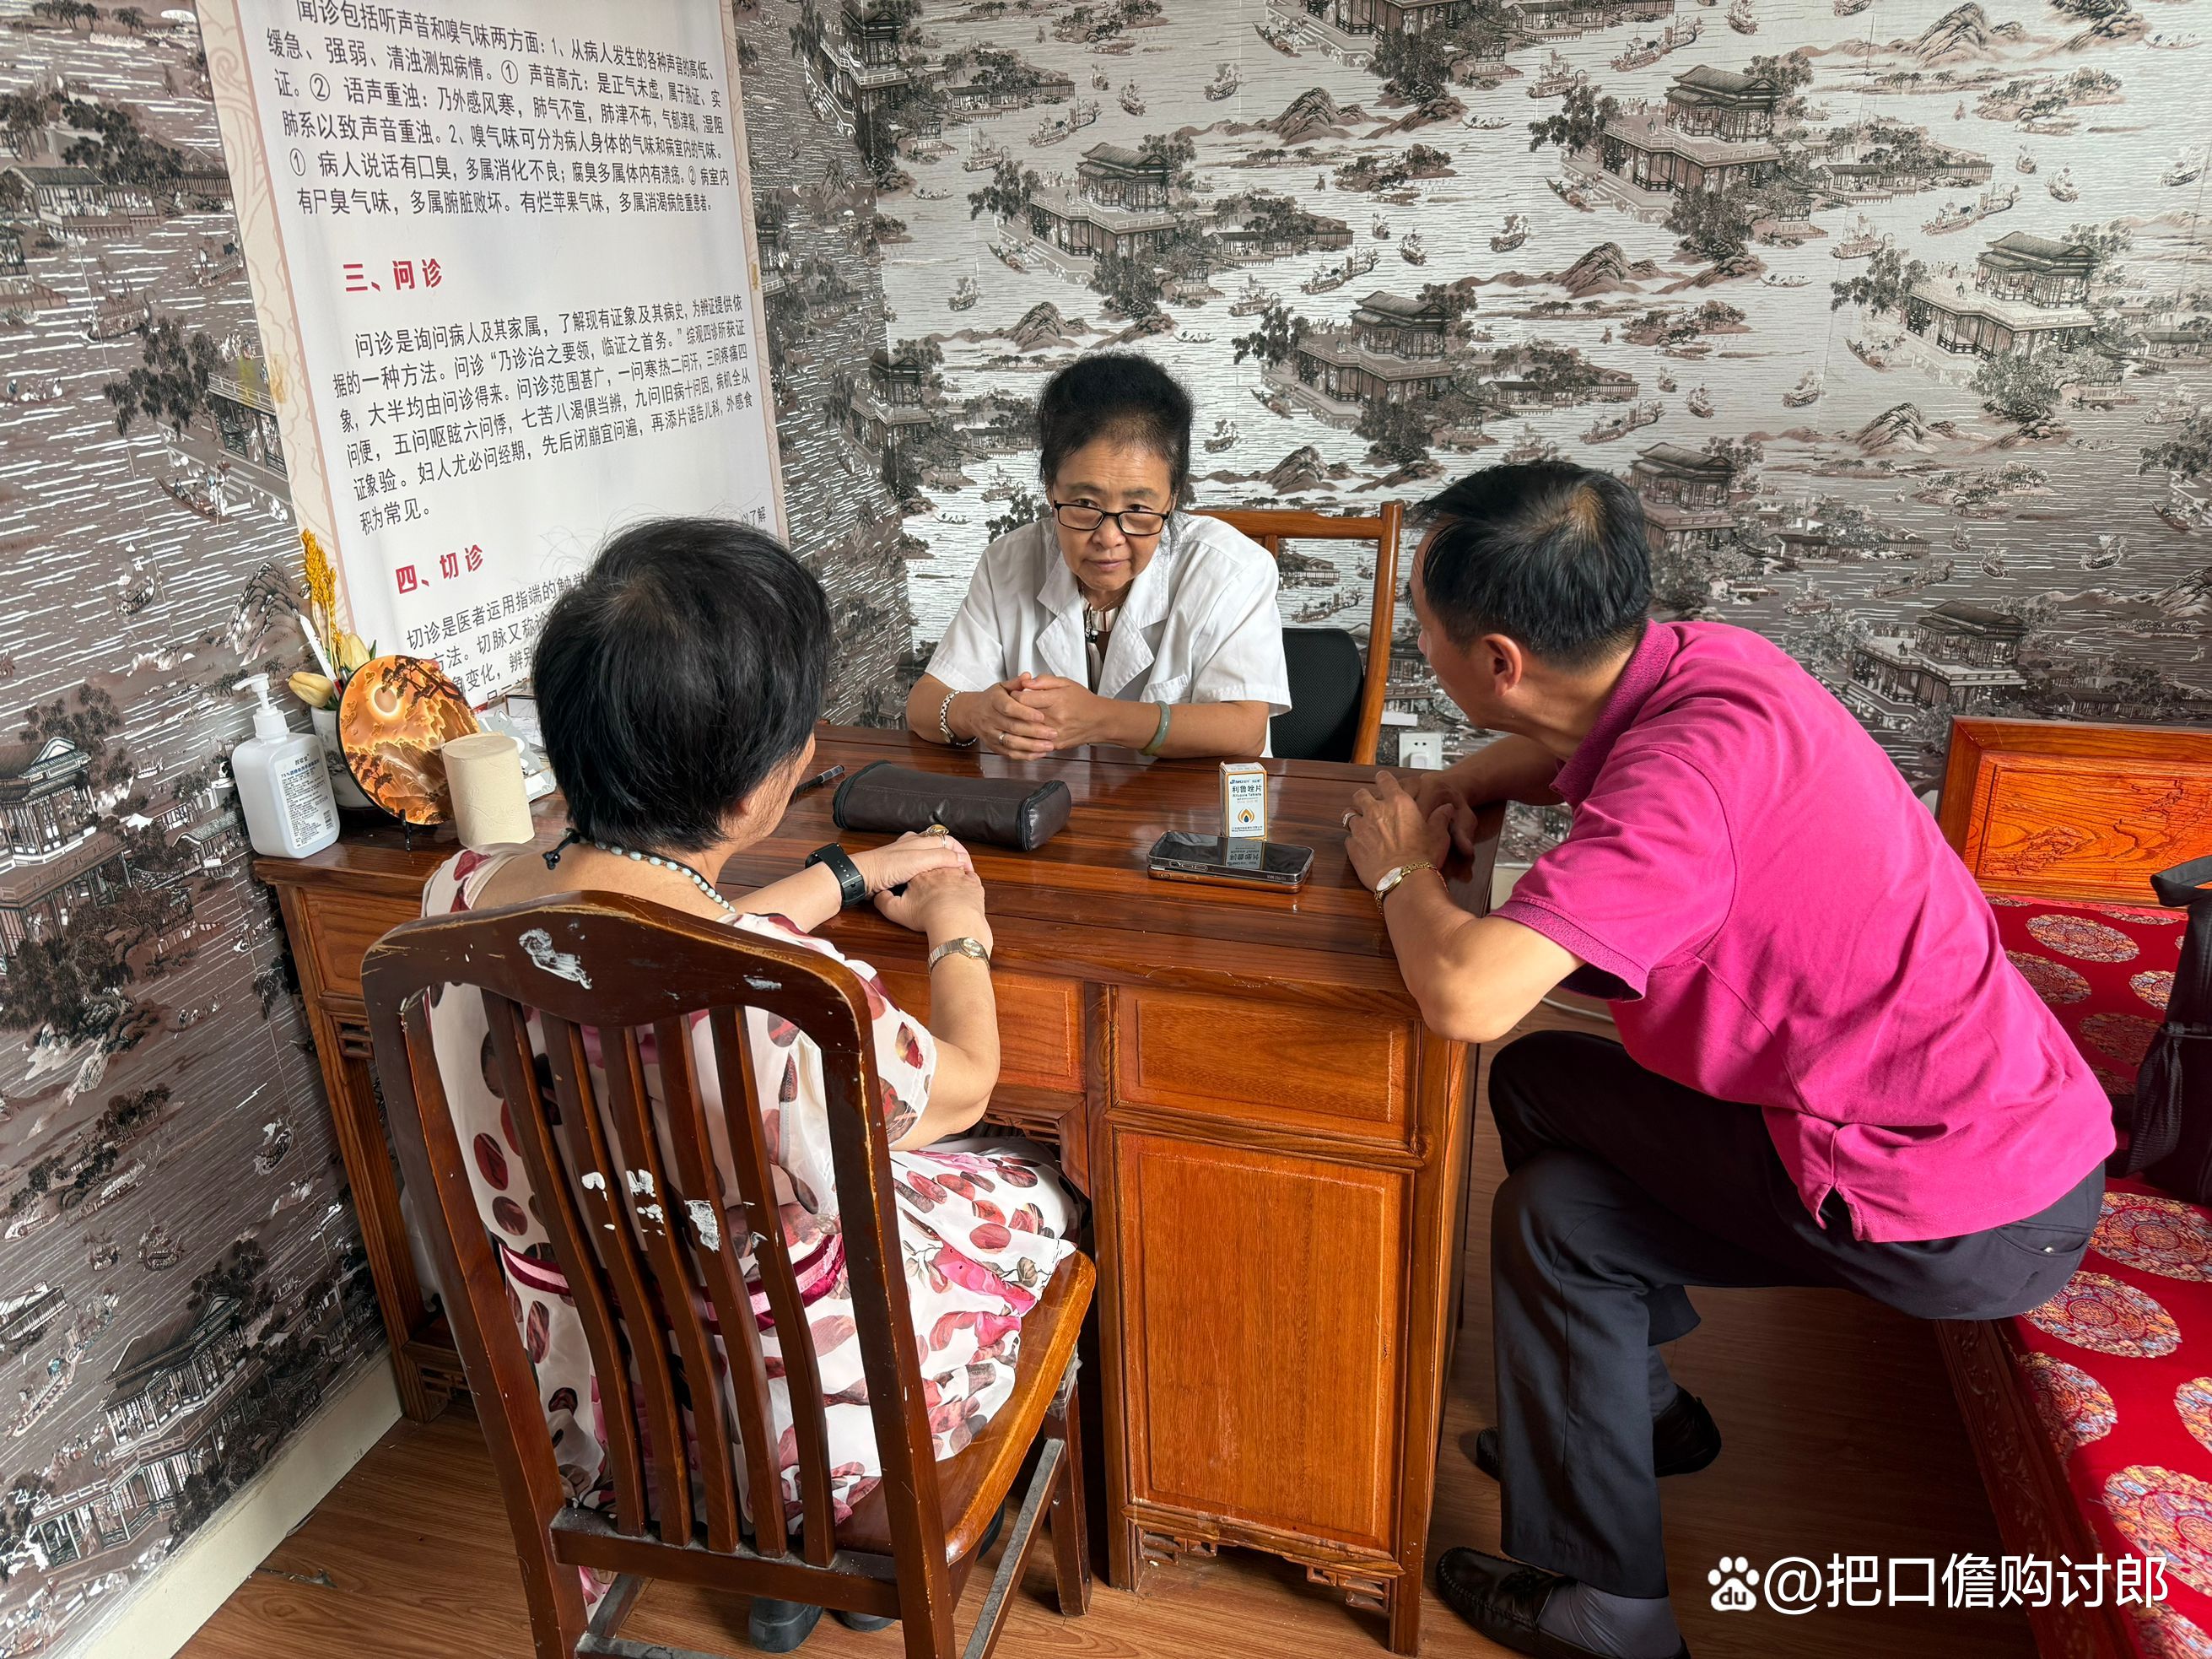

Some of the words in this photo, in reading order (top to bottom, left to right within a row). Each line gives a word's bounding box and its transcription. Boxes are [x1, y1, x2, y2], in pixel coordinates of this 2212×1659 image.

[343, 257, 443, 293] 三、问诊
[359, 497, 431, 537] 积为常见。
[396, 544, 484, 594] 四、切诊
